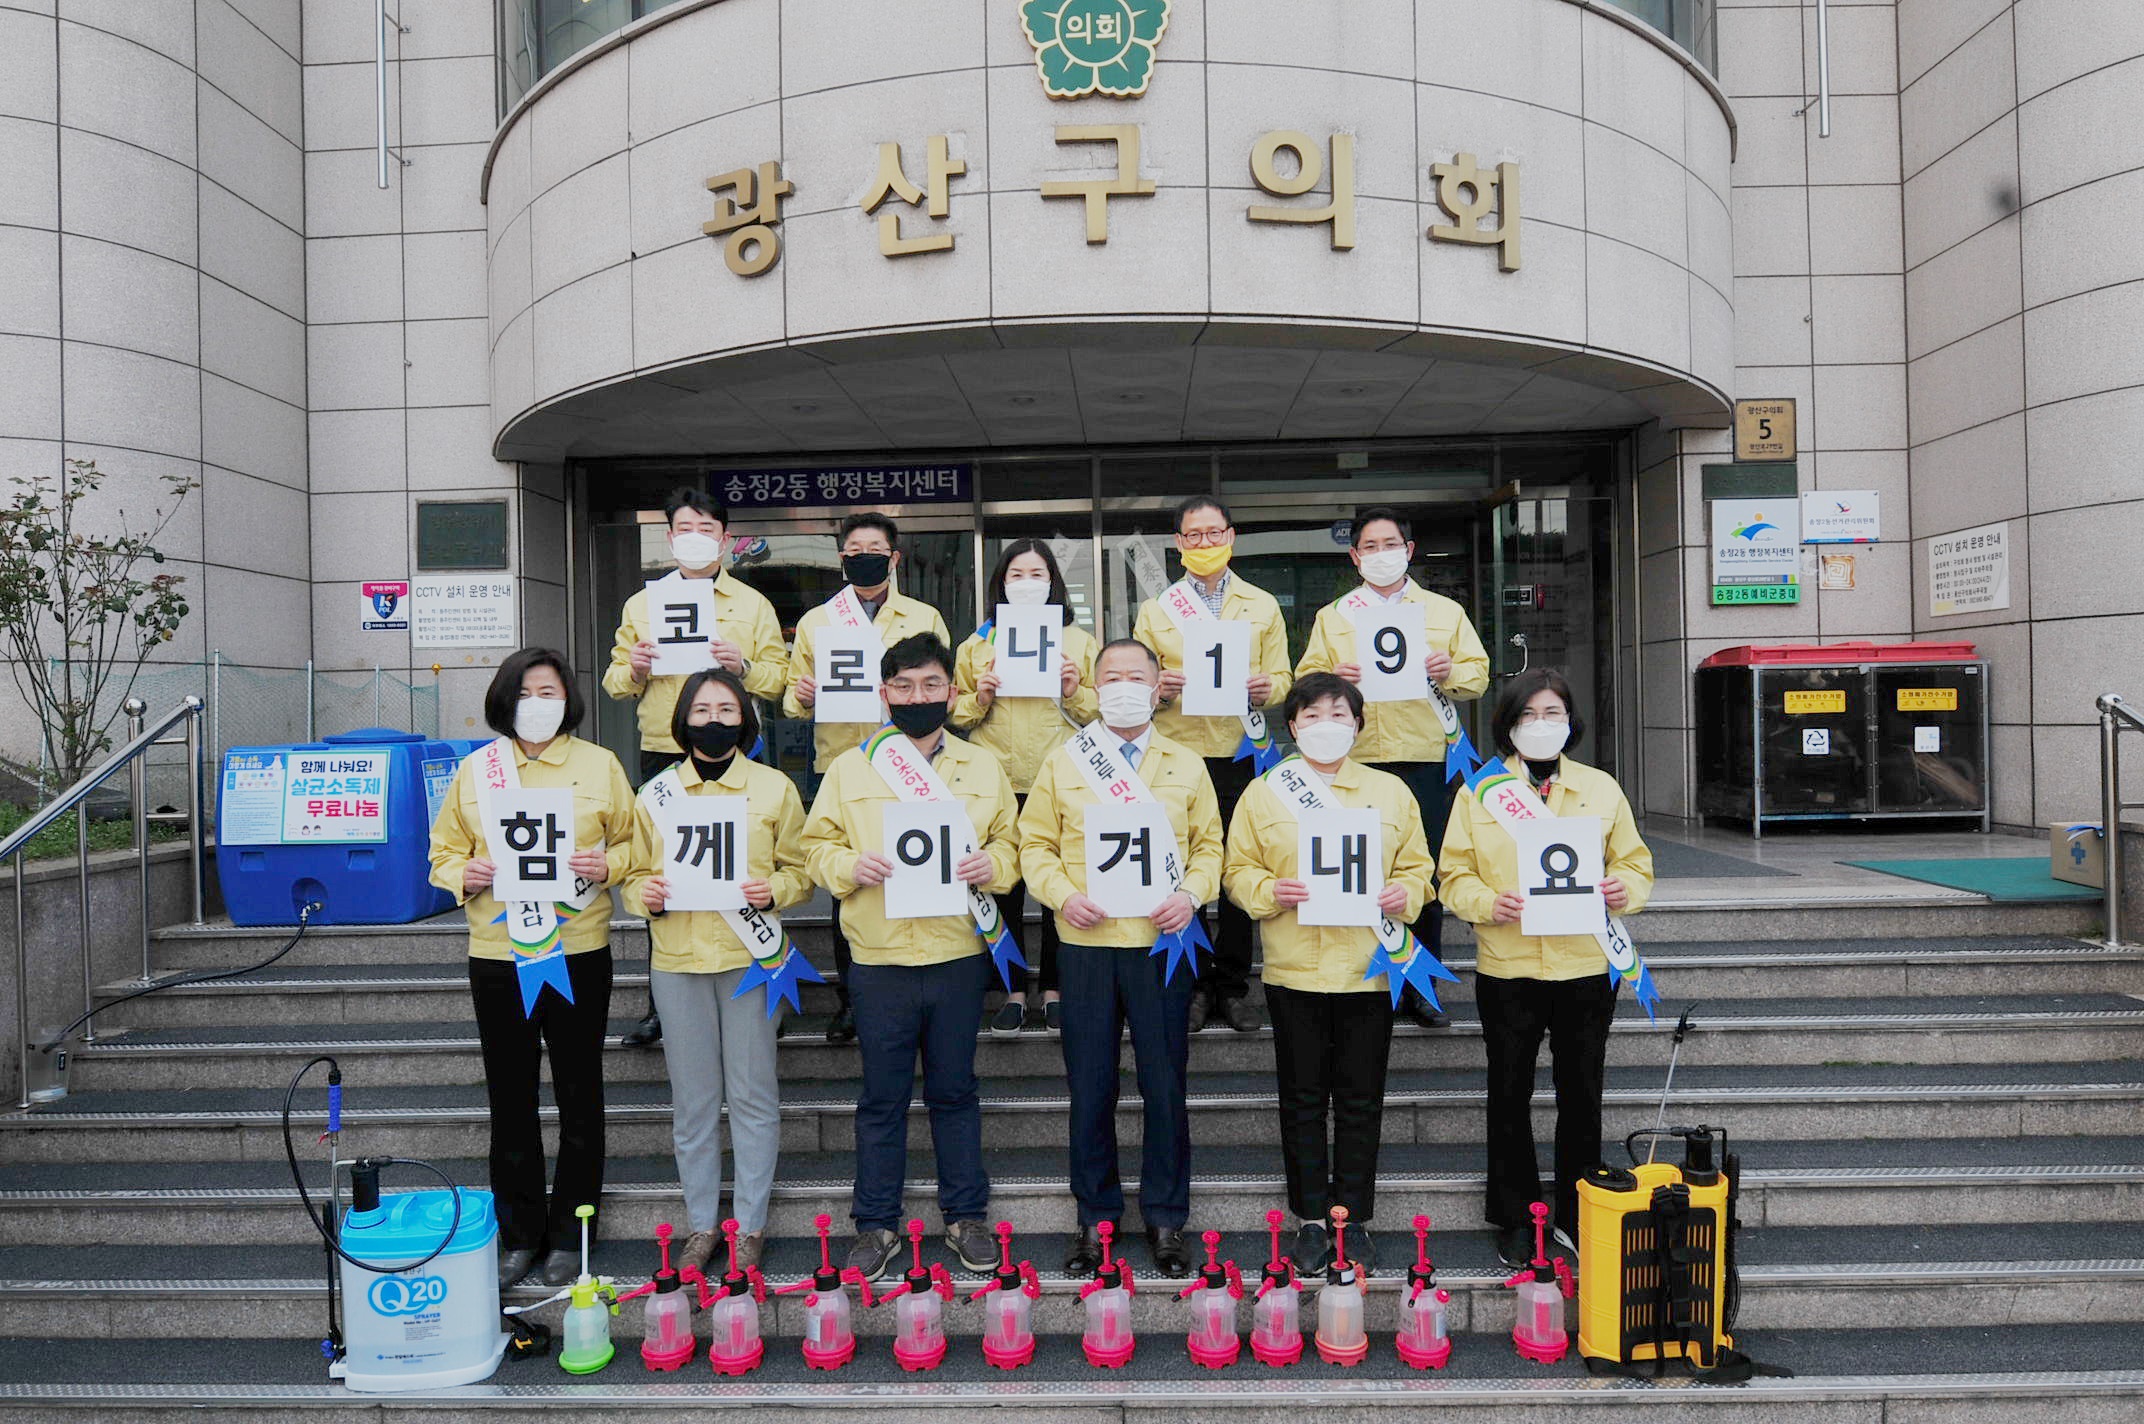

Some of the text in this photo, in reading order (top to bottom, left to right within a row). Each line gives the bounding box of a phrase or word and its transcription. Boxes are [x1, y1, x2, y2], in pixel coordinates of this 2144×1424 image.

[1066, 12, 1121, 45] 의회
[702, 124, 1521, 278] 광산구의회
[1760, 418, 1772, 440] 5
[724, 469, 959, 502] 송정2동 행정복지센터
[1720, 547, 1794, 557] 송정2동 행정복지센터
[1934, 532, 2001, 556] CCTV 설치 운영 안내
[415, 586, 442, 598] CCTV
[445, 584, 465, 599] 설치
[468, 584, 488, 598] 운영
[492, 584, 511, 598] 안내
[1716, 588, 1796, 601] 송정2동예비군중대
[658, 603, 709, 644] 코
[1008, 625, 1055, 673] 나
[1373, 626, 1408, 675] 9
[822, 649, 873, 693] 로
[1205, 643, 1223, 689] 1
[301, 760, 373, 774] 함께 나눠요!
[1089, 750, 1116, 781] 모두
[291, 777, 381, 796] 살균소독제
[306, 800, 379, 818] 무료나눔
[500, 811, 566, 882] 함
[673, 821, 735, 882] 께
[896, 824, 952, 885] 이
[1097, 826, 1152, 887] 겨
[1311, 833, 1367, 896] 내
[1529, 842, 1594, 896] 요
[520, 901, 544, 928] 시다
[371, 1279, 443, 1313] Q20
[414, 1312, 441, 1320] SPRAYER
